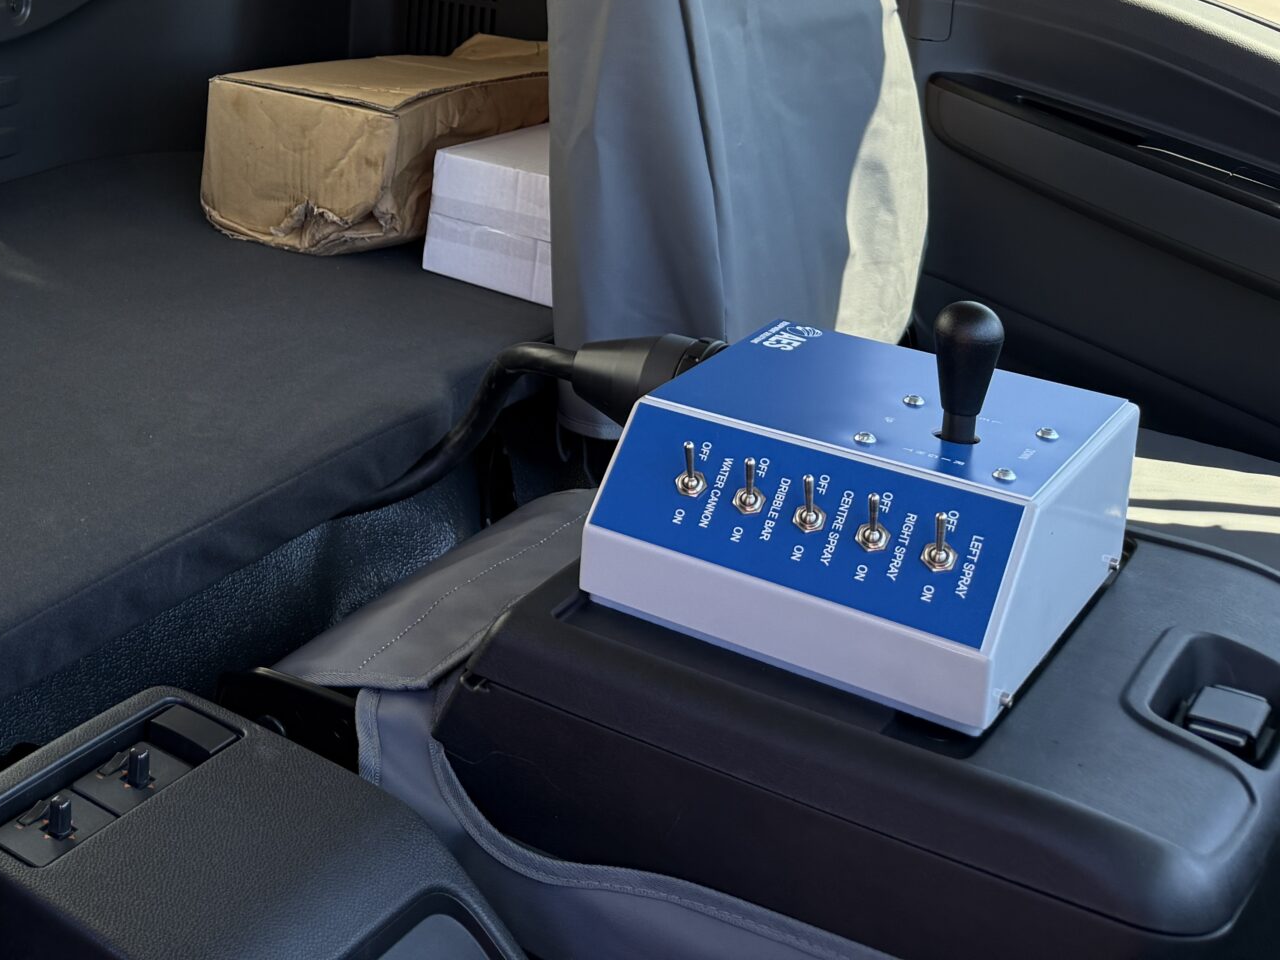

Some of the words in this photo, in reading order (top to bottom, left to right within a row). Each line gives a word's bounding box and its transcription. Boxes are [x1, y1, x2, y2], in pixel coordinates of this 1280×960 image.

[762, 331, 807, 351] AES
[698, 441, 713, 462] OFF
[713, 457, 734, 489] WATER
[756, 457, 770, 478] OFF
[816, 474, 831, 496] OFF
[698, 489, 721, 529] CANNON
[768, 477, 792, 519] DRIBBLE
[879, 491, 894, 514] OFF
[672, 508, 686, 525] ON
[831, 490, 855, 531] CENTRE
[945, 510, 960, 533] OFF
[730, 526, 744, 543] ON
[759, 517, 776, 542] BAR
[898, 512, 918, 546] RIGHT
[790, 544, 805, 562] ON
[820, 531, 840, 567] SPRAY
[969, 534, 985, 563] LEFT
[853, 564, 869, 582] ON
[886, 546, 907, 582] SPRAY
[954, 562, 976, 599] SPRAY
[920, 584, 935, 603] ON
